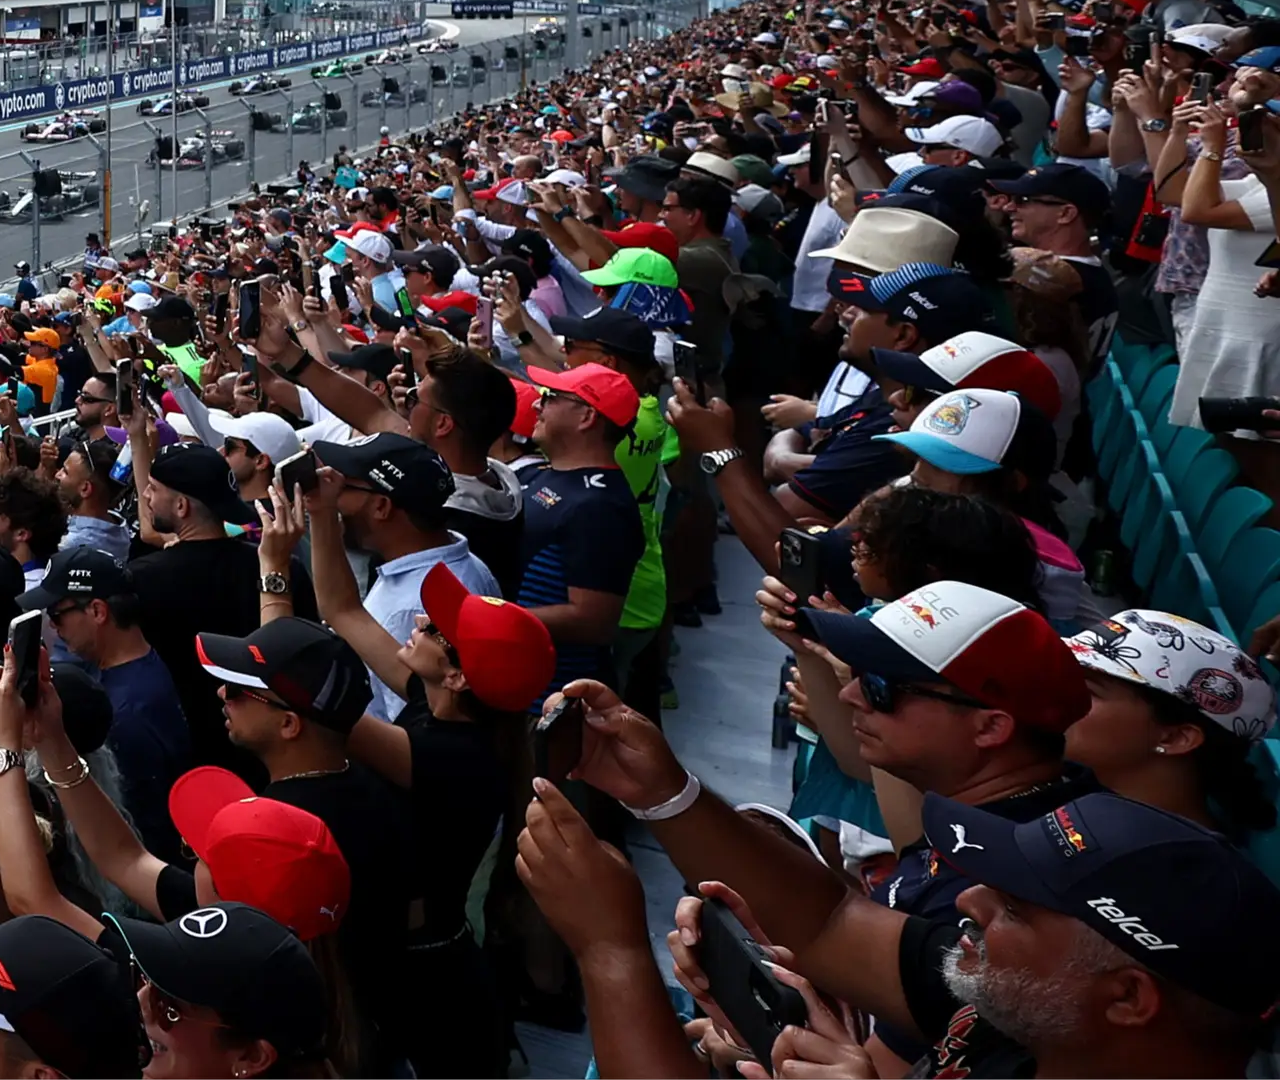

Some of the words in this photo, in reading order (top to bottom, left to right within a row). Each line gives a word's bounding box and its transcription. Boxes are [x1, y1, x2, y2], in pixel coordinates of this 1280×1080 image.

[464, 3, 511, 13] crypto.com
[189, 61, 224, 81] crypto.com
[237, 53, 269, 71] crypto.com
[133, 70, 173, 92] crypto.com
[68, 79, 115, 104] crypto.com
[909, 291, 938, 310] telcel
[388, 463, 405, 480] FTX
[76, 570, 91, 578] FTX
[920, 589, 960, 621] CLE
[1087, 896, 1179, 952] telcel
